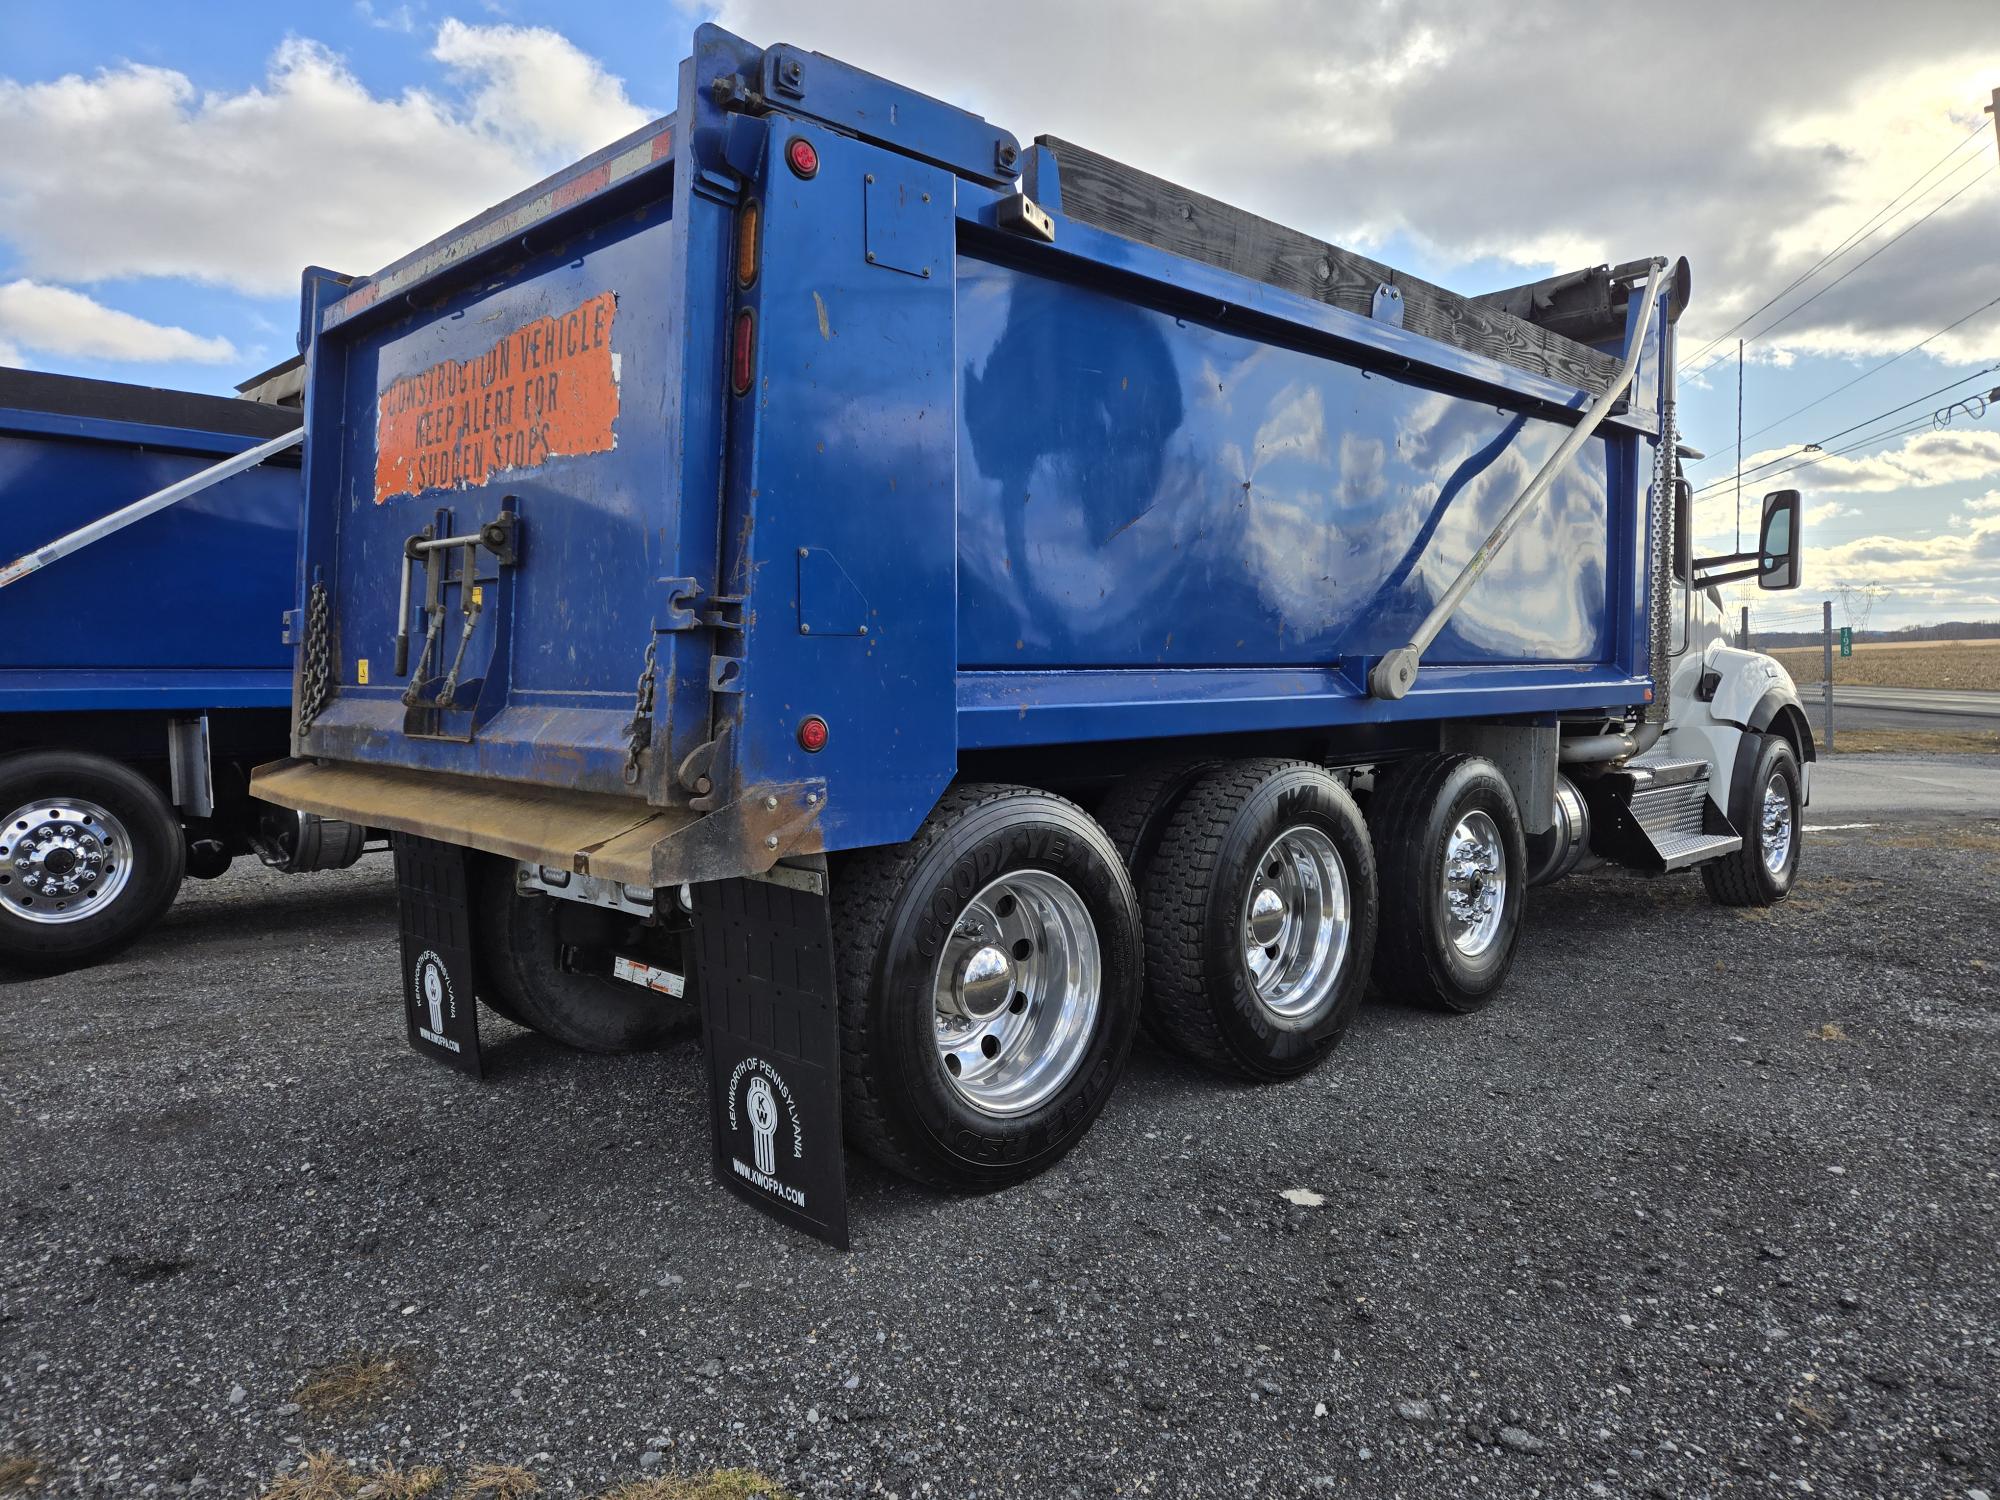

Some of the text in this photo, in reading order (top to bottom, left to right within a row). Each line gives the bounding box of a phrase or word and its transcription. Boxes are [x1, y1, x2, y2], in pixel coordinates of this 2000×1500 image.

[520, 304, 604, 373] VEHICLE
[415, 371, 559, 449] KEEP ALERT FOR
[417, 422, 550, 488] SUDDEN STOPS
[728, 1057, 803, 1159] KENWORTH OF PENNSYLVANIA
[732, 1157, 805, 1207] WWW.KWOFPA.COM
